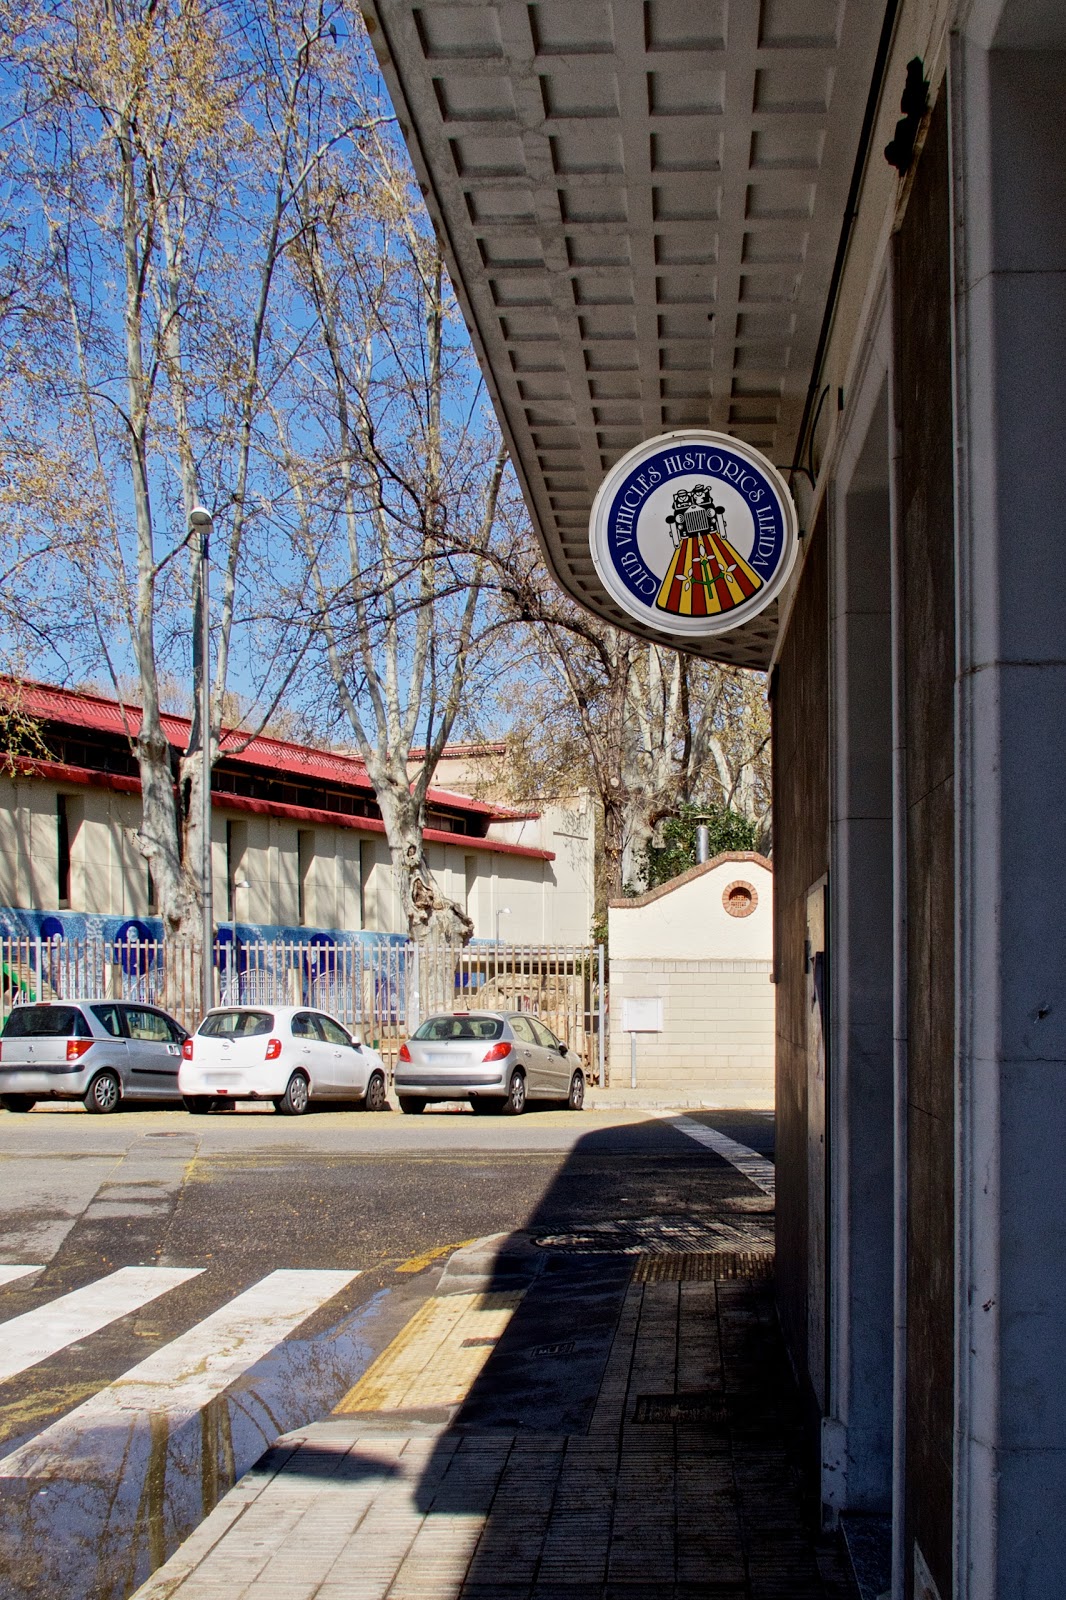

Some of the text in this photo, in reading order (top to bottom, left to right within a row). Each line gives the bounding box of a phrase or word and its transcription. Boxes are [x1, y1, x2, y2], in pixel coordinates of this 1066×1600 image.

[615, 452, 776, 595] CLUB VEHICLES HISTORICS LLEIDA
